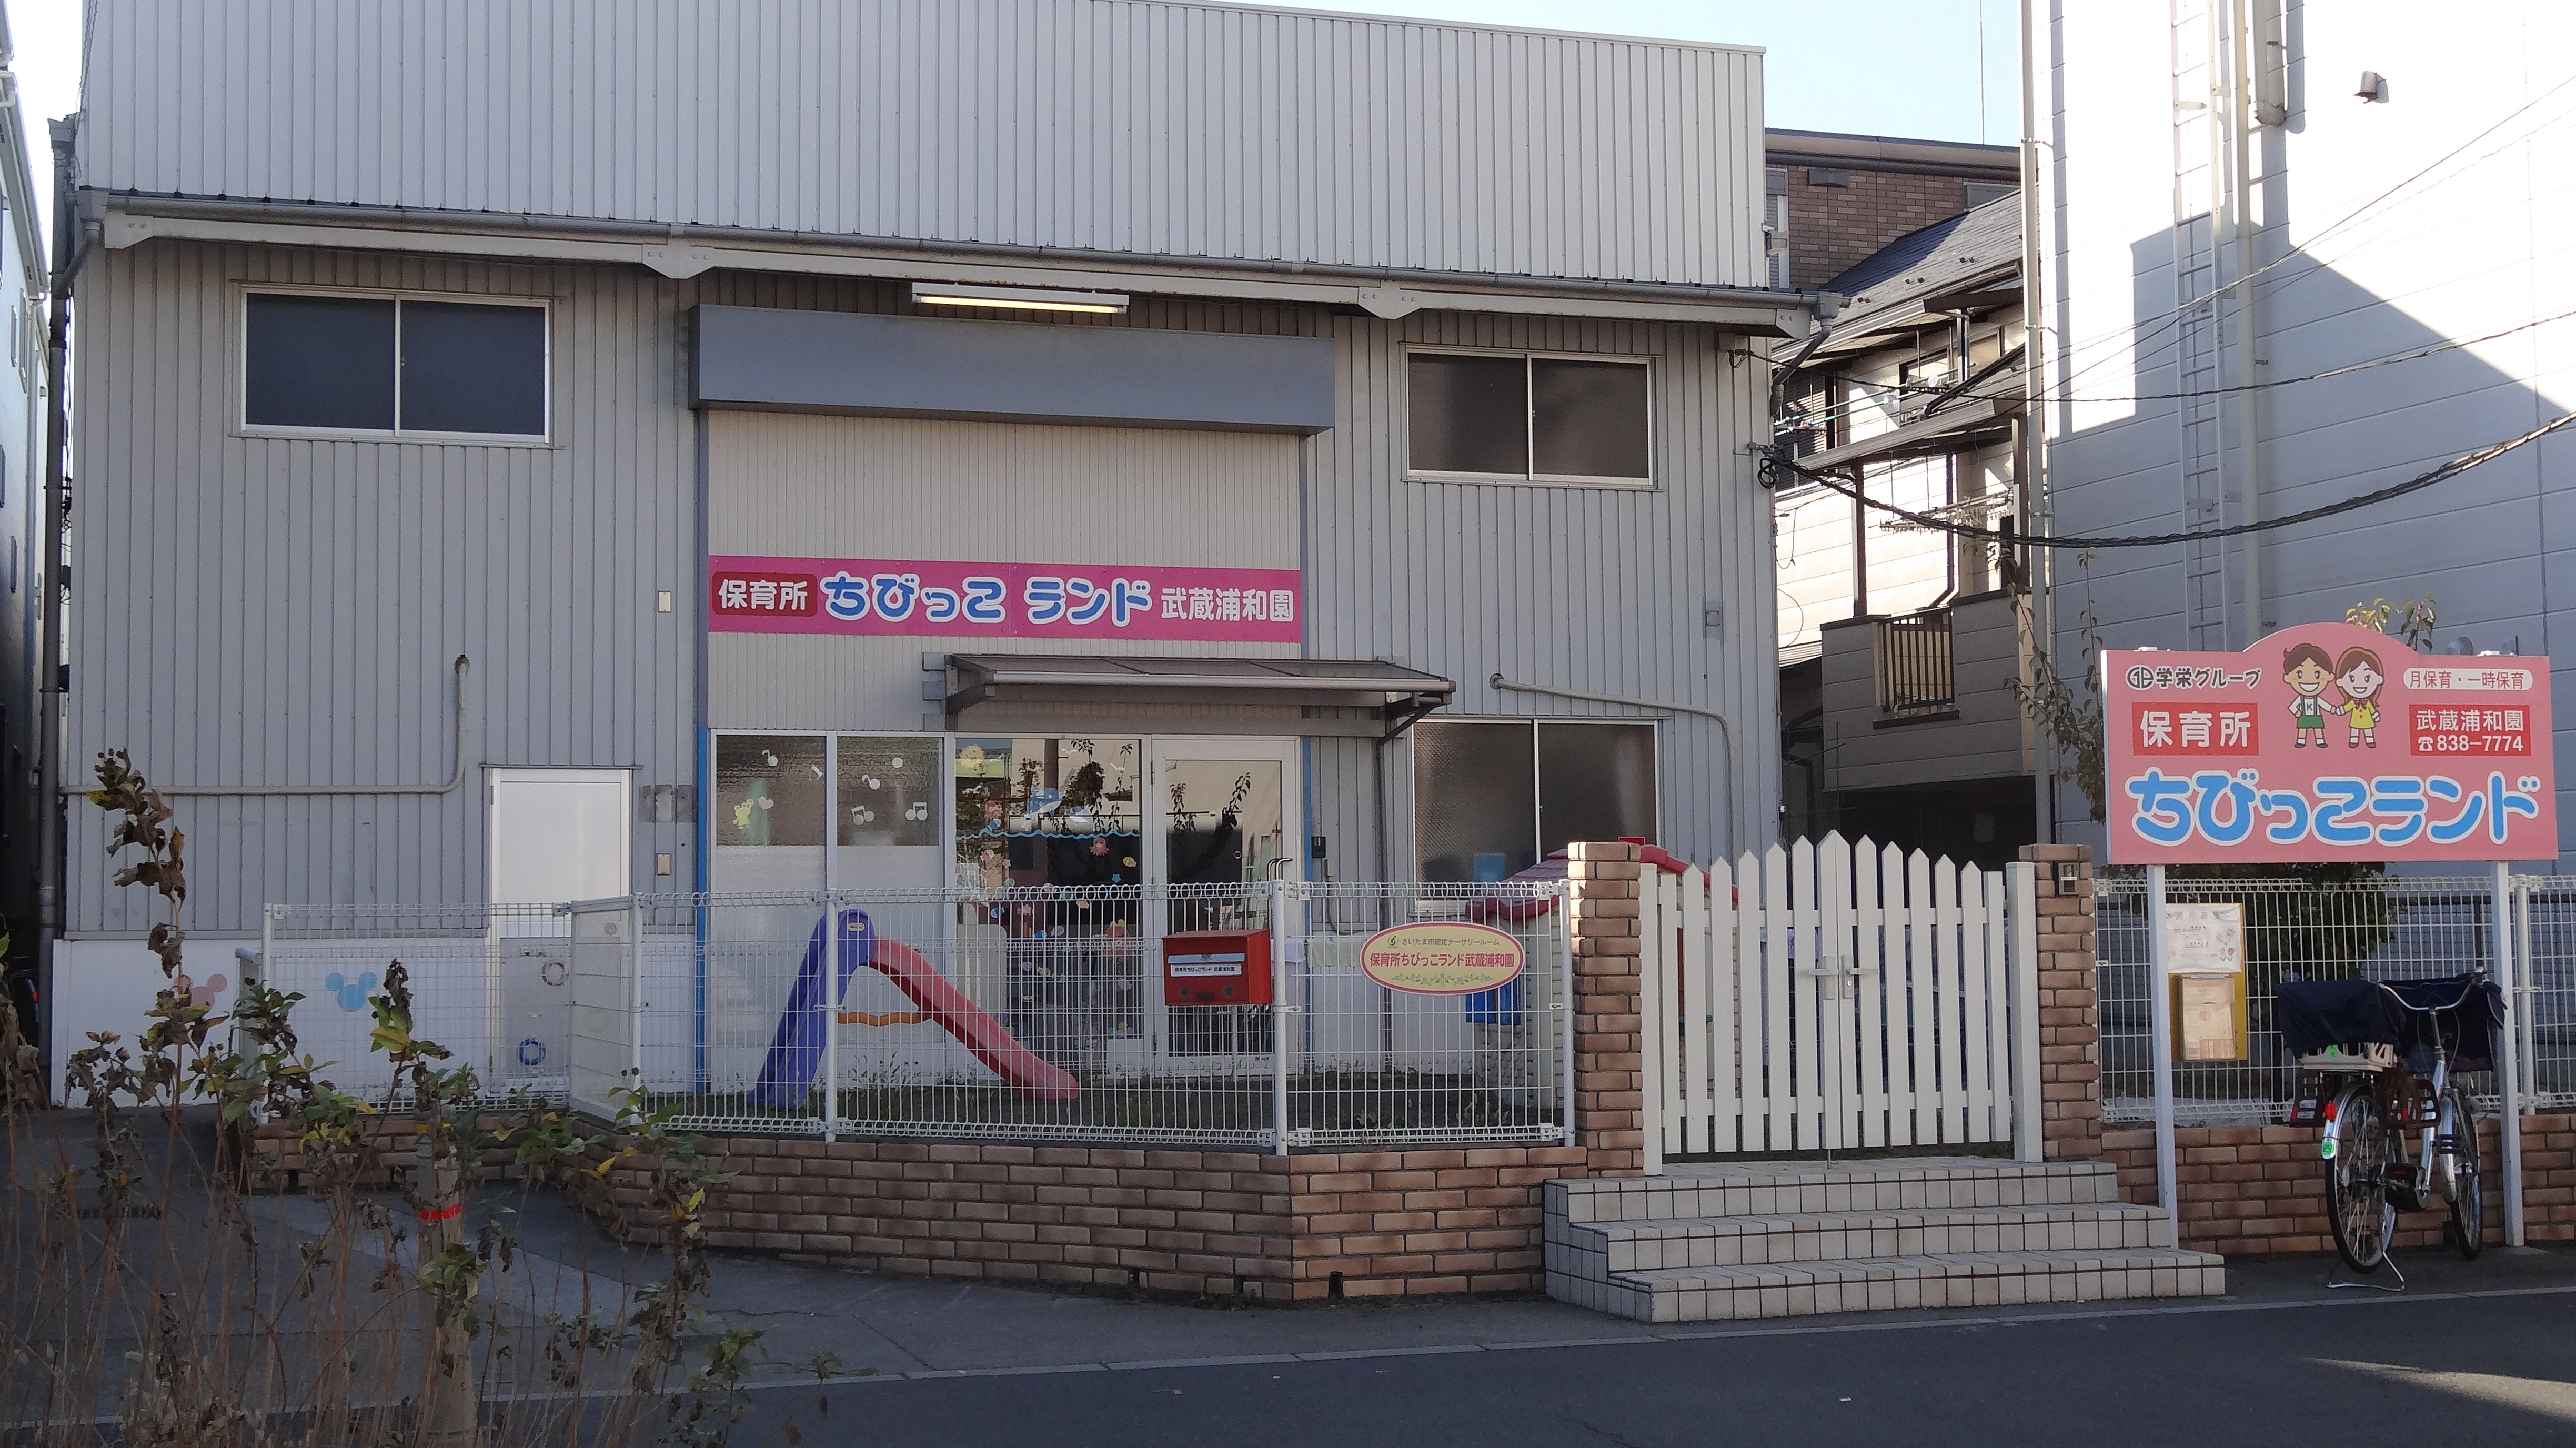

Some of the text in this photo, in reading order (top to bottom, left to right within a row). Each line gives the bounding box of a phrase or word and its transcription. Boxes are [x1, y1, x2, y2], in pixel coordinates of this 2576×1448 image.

[718, 571, 1294, 627] 保育所 ちびっこ ランド 武蔵浦和園
[2140, 710, 2251, 748] 保育所
[2416, 709, 2524, 732] 武蔵浦和園
[2125, 767, 2541, 847] ちびっこランド
